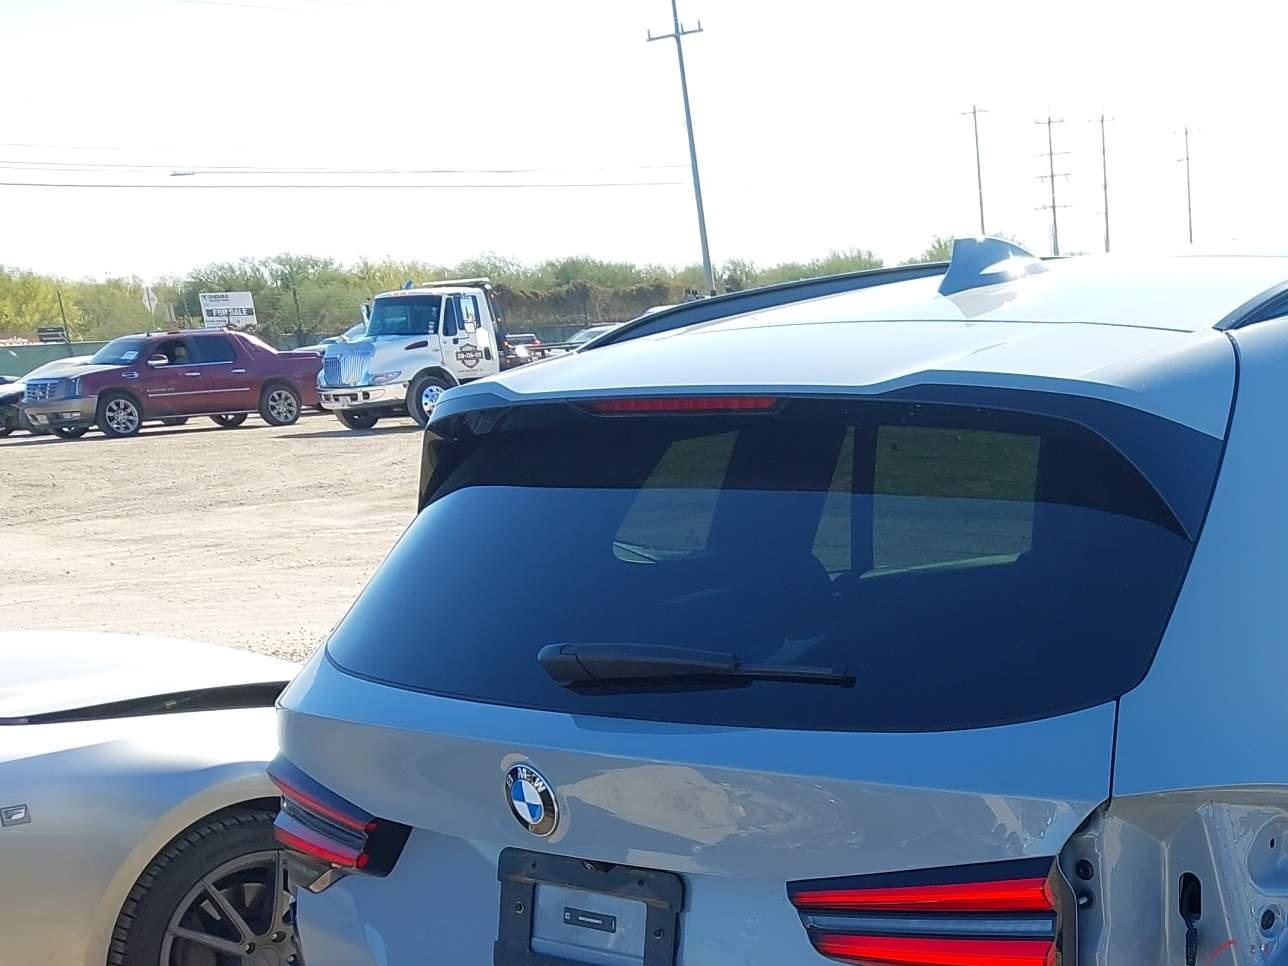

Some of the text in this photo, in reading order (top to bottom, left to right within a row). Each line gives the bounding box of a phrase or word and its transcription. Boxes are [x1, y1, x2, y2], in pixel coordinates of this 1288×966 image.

[212, 307, 249, 317] FOR SALE
[506, 767, 546, 793] BMW
